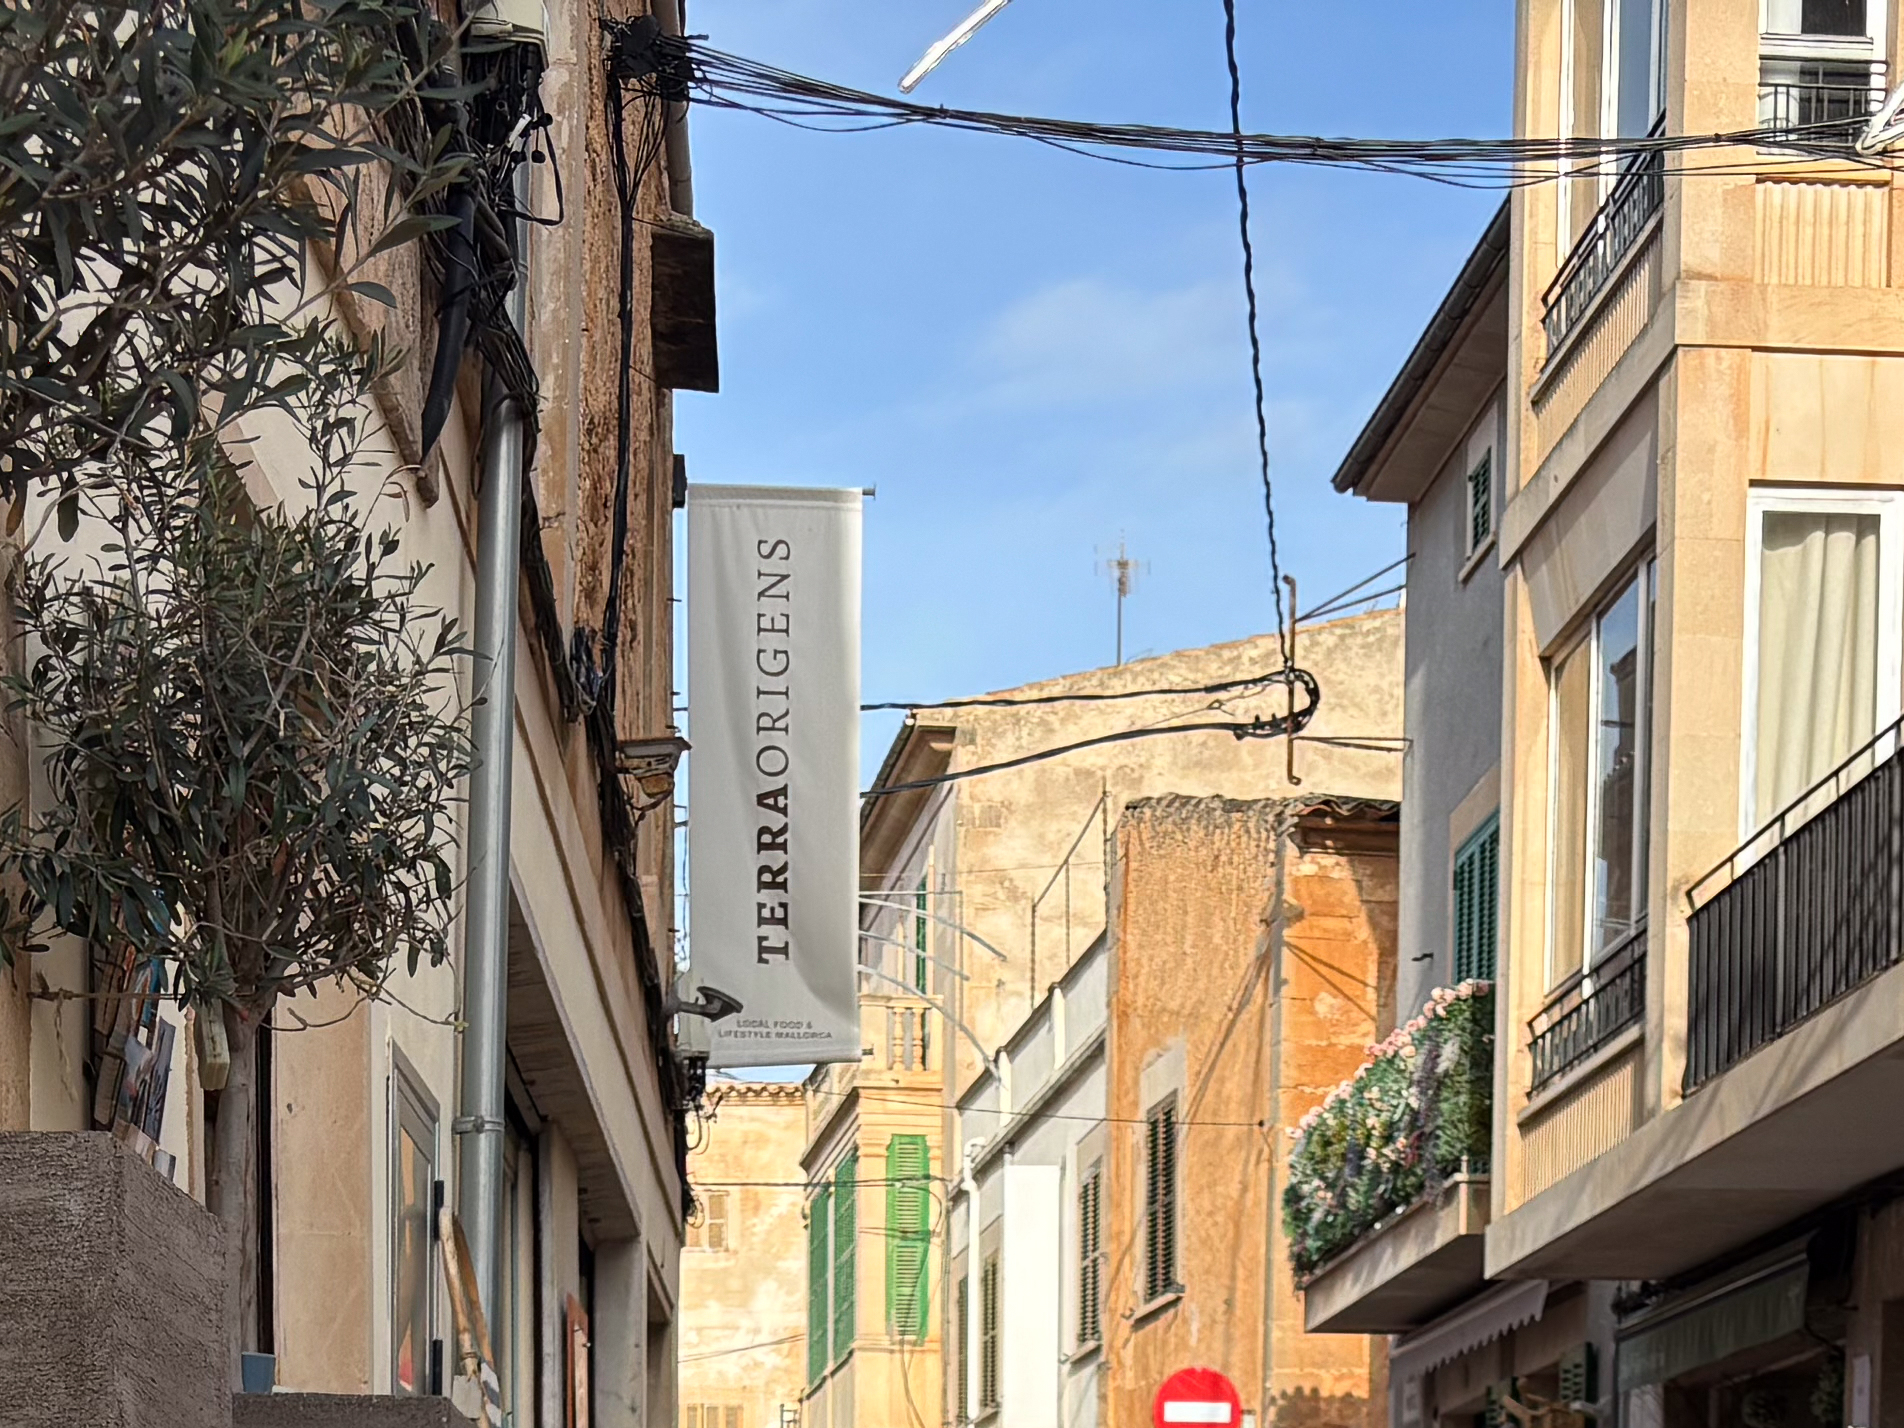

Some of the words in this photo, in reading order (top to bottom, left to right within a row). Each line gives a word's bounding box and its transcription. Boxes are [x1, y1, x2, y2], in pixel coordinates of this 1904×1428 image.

[736, 1019, 770, 1030] LOCAL
[773, 1020, 804, 1030] FOOD
[718, 1029, 771, 1039] LIFESTYLE
[774, 1031, 833, 1040] MALLORCA
